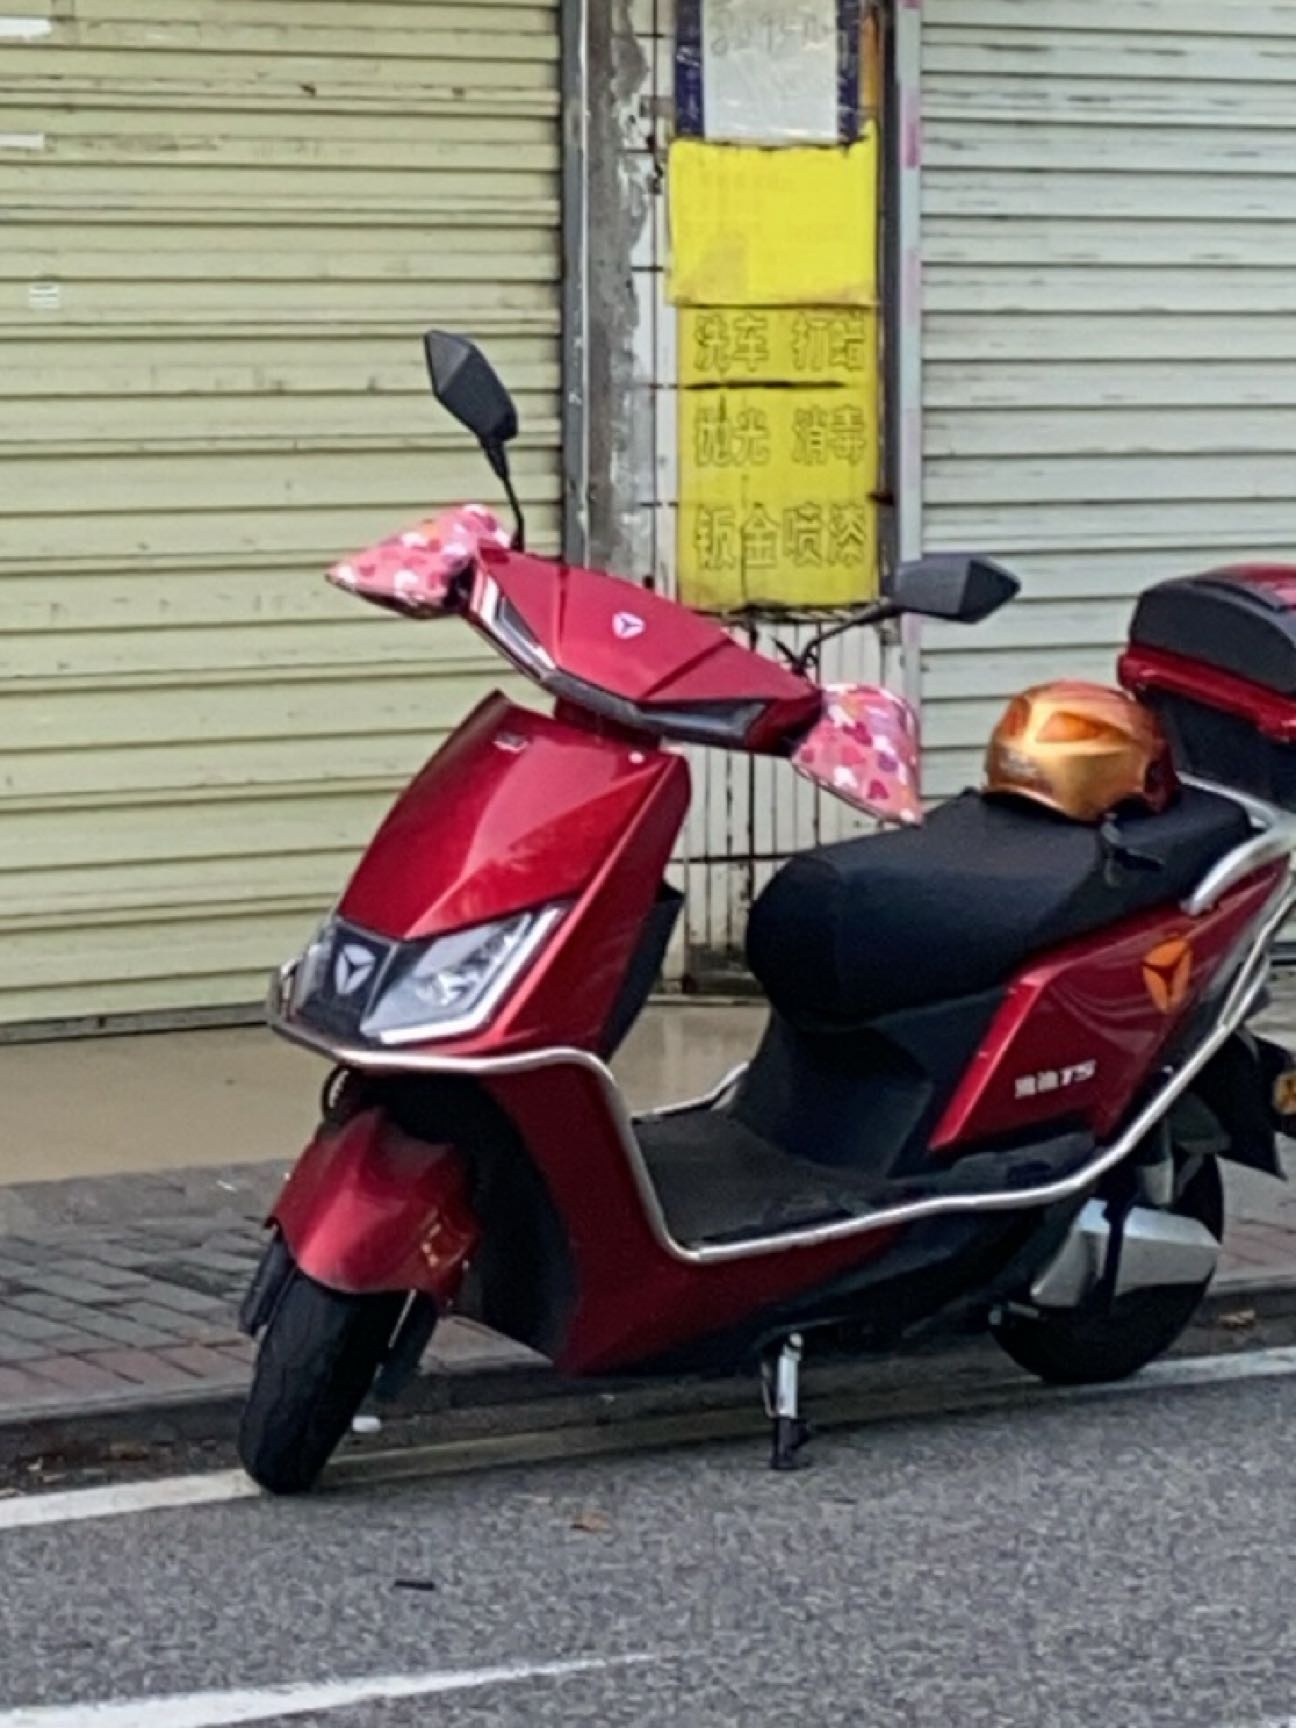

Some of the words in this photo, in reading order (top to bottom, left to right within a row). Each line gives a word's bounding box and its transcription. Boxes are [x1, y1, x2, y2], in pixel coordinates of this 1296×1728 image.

[694, 312, 768, 373] 洗车
[792, 404, 866, 466] 消毒
[693, 501, 866, 569] 钣金喷漆
